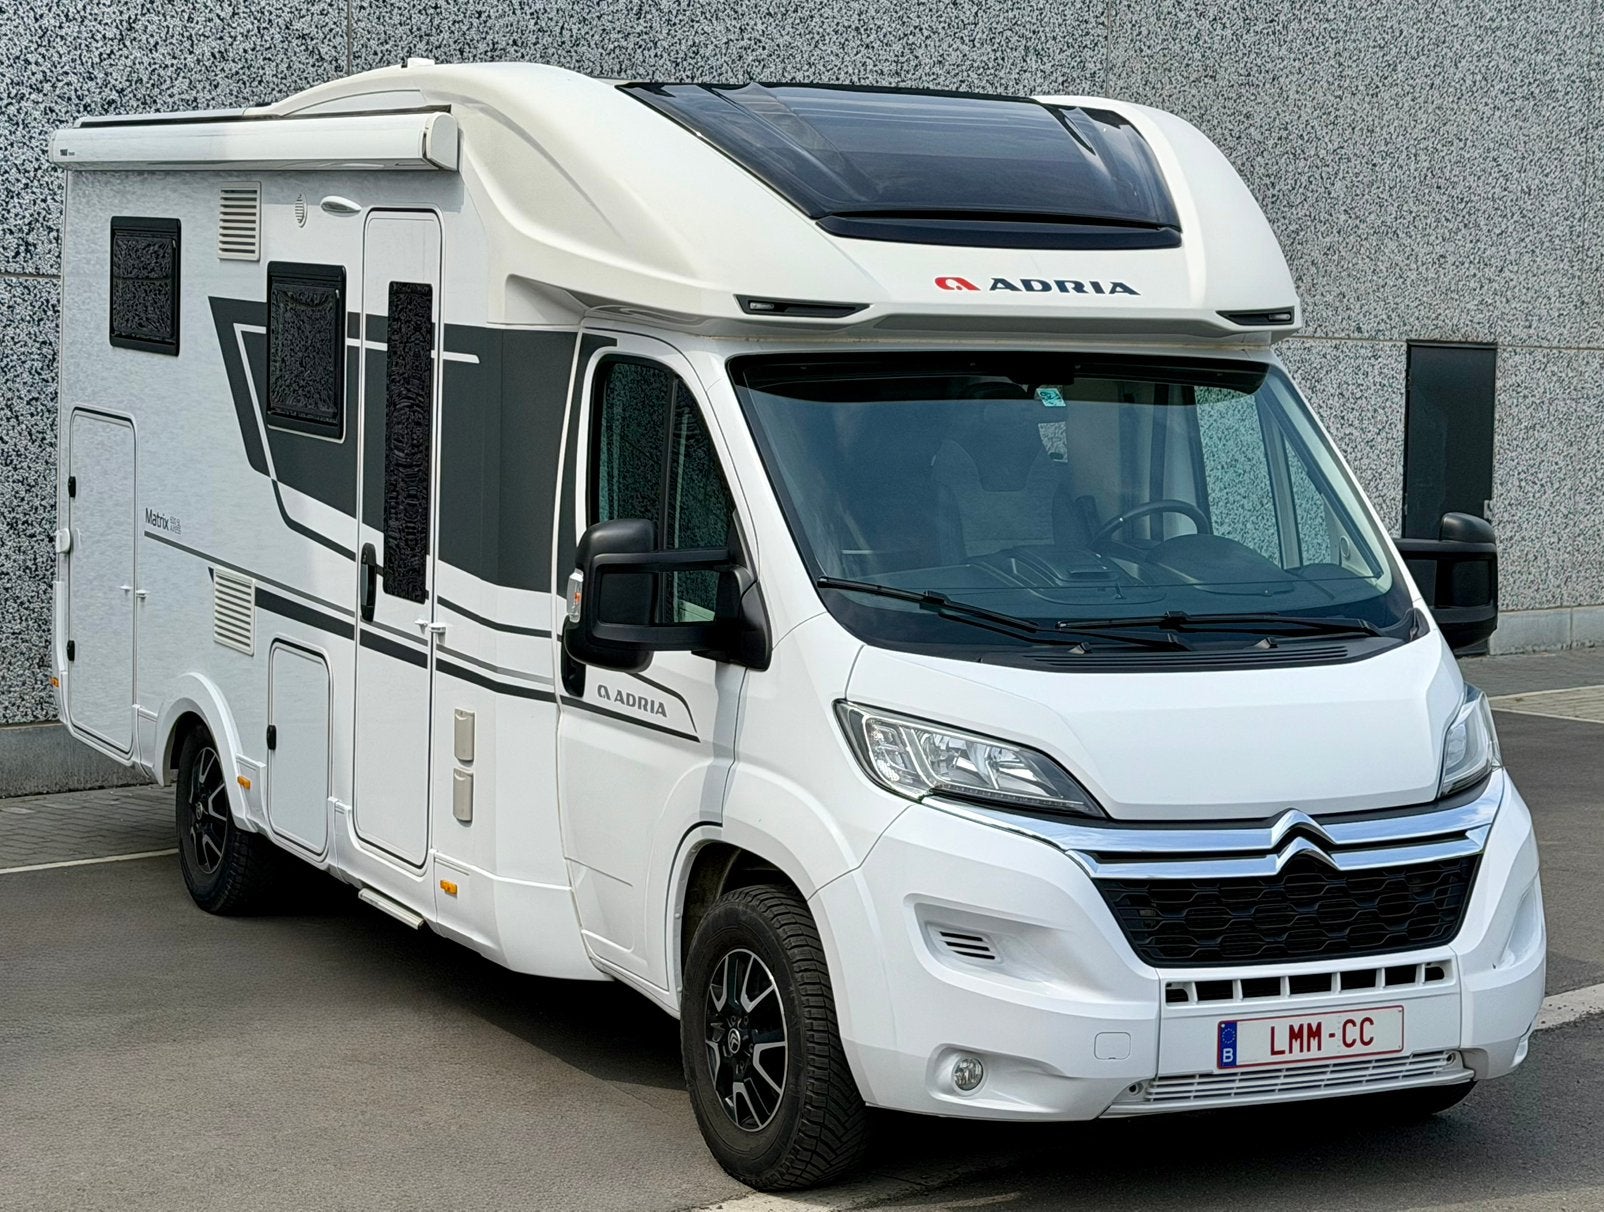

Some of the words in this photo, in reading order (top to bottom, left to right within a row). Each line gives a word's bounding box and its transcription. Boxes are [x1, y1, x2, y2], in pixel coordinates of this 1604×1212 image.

[989, 277, 1141, 296] ADRIA
[145, 507, 170, 531] Matrix
[613, 689, 668, 718] ADRIA
[1270, 1016, 1375, 1056] LMM-CC
[1222, 1048, 1234, 1063] B
